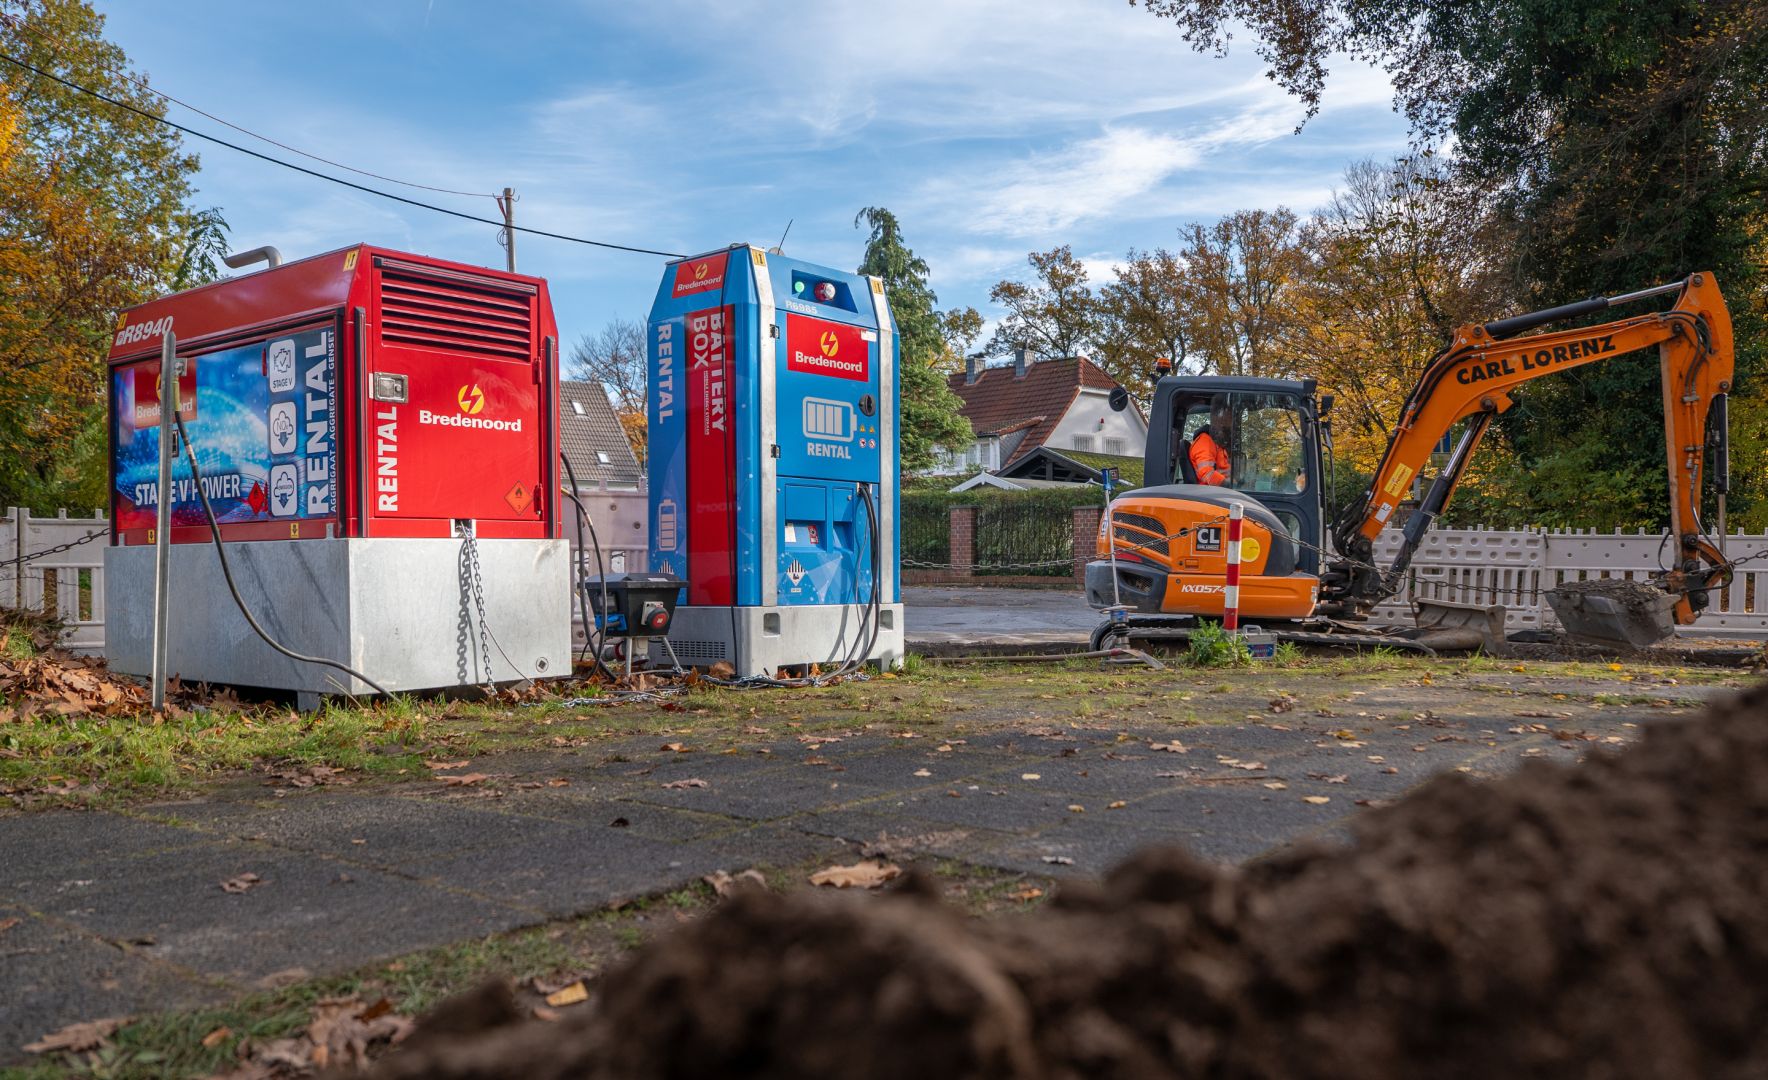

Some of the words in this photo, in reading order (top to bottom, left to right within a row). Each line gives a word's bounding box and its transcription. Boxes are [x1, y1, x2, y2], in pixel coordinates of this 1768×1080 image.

[677, 275, 722, 292] Bredenoord
[693, 316, 709, 369] BOX
[795, 351, 862, 373] Bredenoord
[1456, 359, 1515, 385] CARL
[1521, 335, 1616, 371] LORENZ
[272, 379, 288, 389] STAGE
[289, 377, 293, 386] V
[658, 323, 673, 424] RENTAL
[710, 312, 727, 432] BATTERY
[136, 397, 193, 418] Brederd
[305, 331, 329, 515] RENTAL
[328, 378, 336, 440] AGGREGATE
[419, 409, 522, 432] Bredenoord
[378, 406, 398, 512] RENTAL
[807, 442, 852, 460] RENTAL
[135, 482, 177, 505] STAE
[178, 479, 189, 502] V
[191, 474, 241, 501] POWER
[329, 449, 337, 513] AGGREGAAT
[1197, 528, 1220, 544] CL
